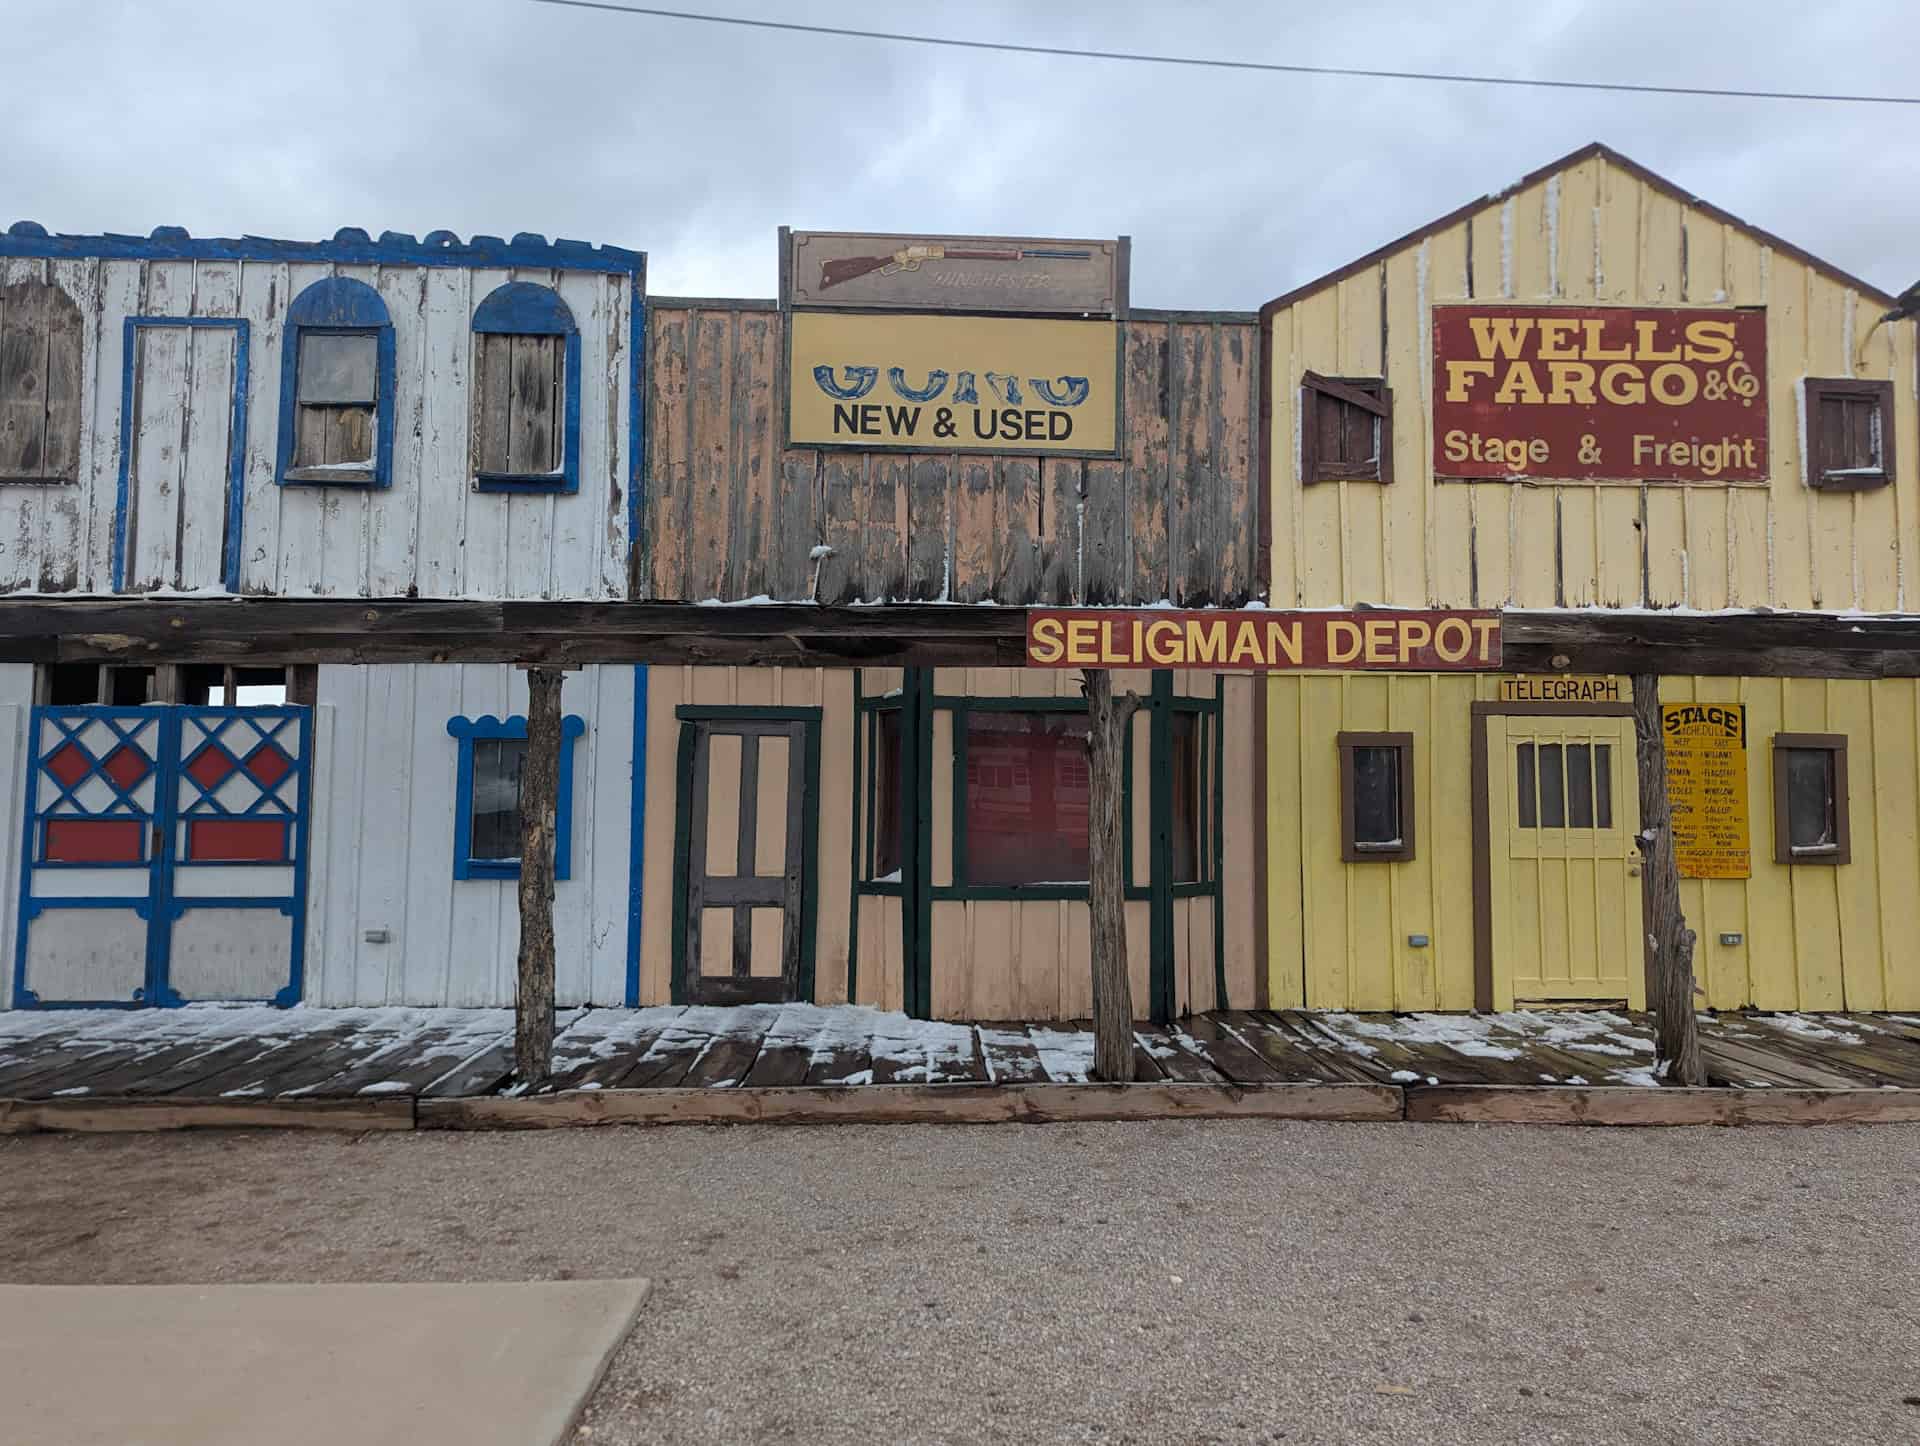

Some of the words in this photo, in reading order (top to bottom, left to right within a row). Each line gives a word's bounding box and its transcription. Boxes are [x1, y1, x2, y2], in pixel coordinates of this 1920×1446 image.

[933, 272, 1051, 288] WINCHESTER
[1445, 360, 1699, 406] FARGO
[1703, 370, 1727, 401] &
[833, 404, 921, 436] NEW
[933, 408, 958, 438] &
[973, 409, 1073, 441] USED
[1444, 430, 1549, 471] Stage
[1577, 434, 1602, 465] &
[1633, 434, 1757, 475] Freight
[1029, 618, 1304, 664] SELIGMAN
[1326, 618, 1499, 664] DEPOT
[1504, 680, 1619, 700] TELEGRAPH
[1665, 706, 1738, 732] STAGE
